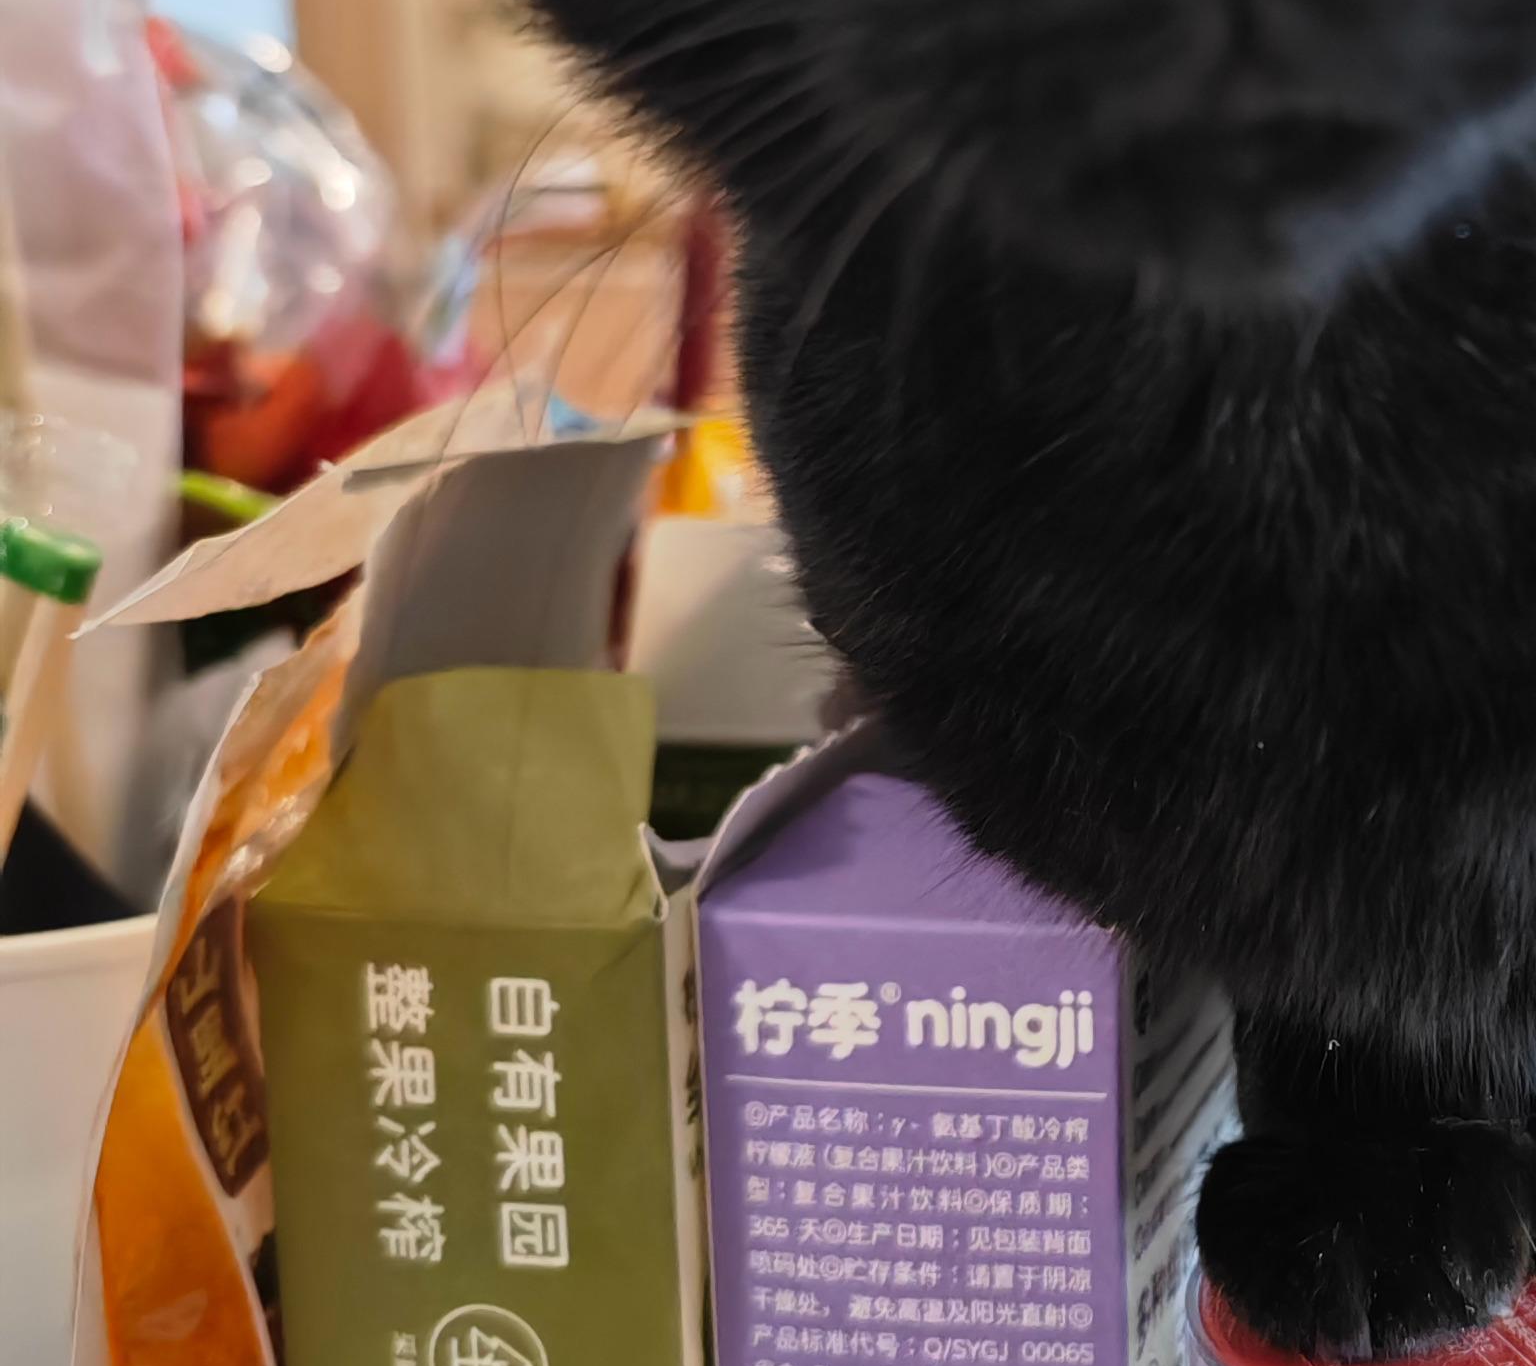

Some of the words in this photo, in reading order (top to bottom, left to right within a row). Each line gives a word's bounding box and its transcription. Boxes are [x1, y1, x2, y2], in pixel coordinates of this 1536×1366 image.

[366, 962, 447, 1264] 整果冷榨
[490, 977, 569, 1268] 自有果园
[733, 978, 881, 1060] 柠季
[906, 986, 1094, 1069] ningji
